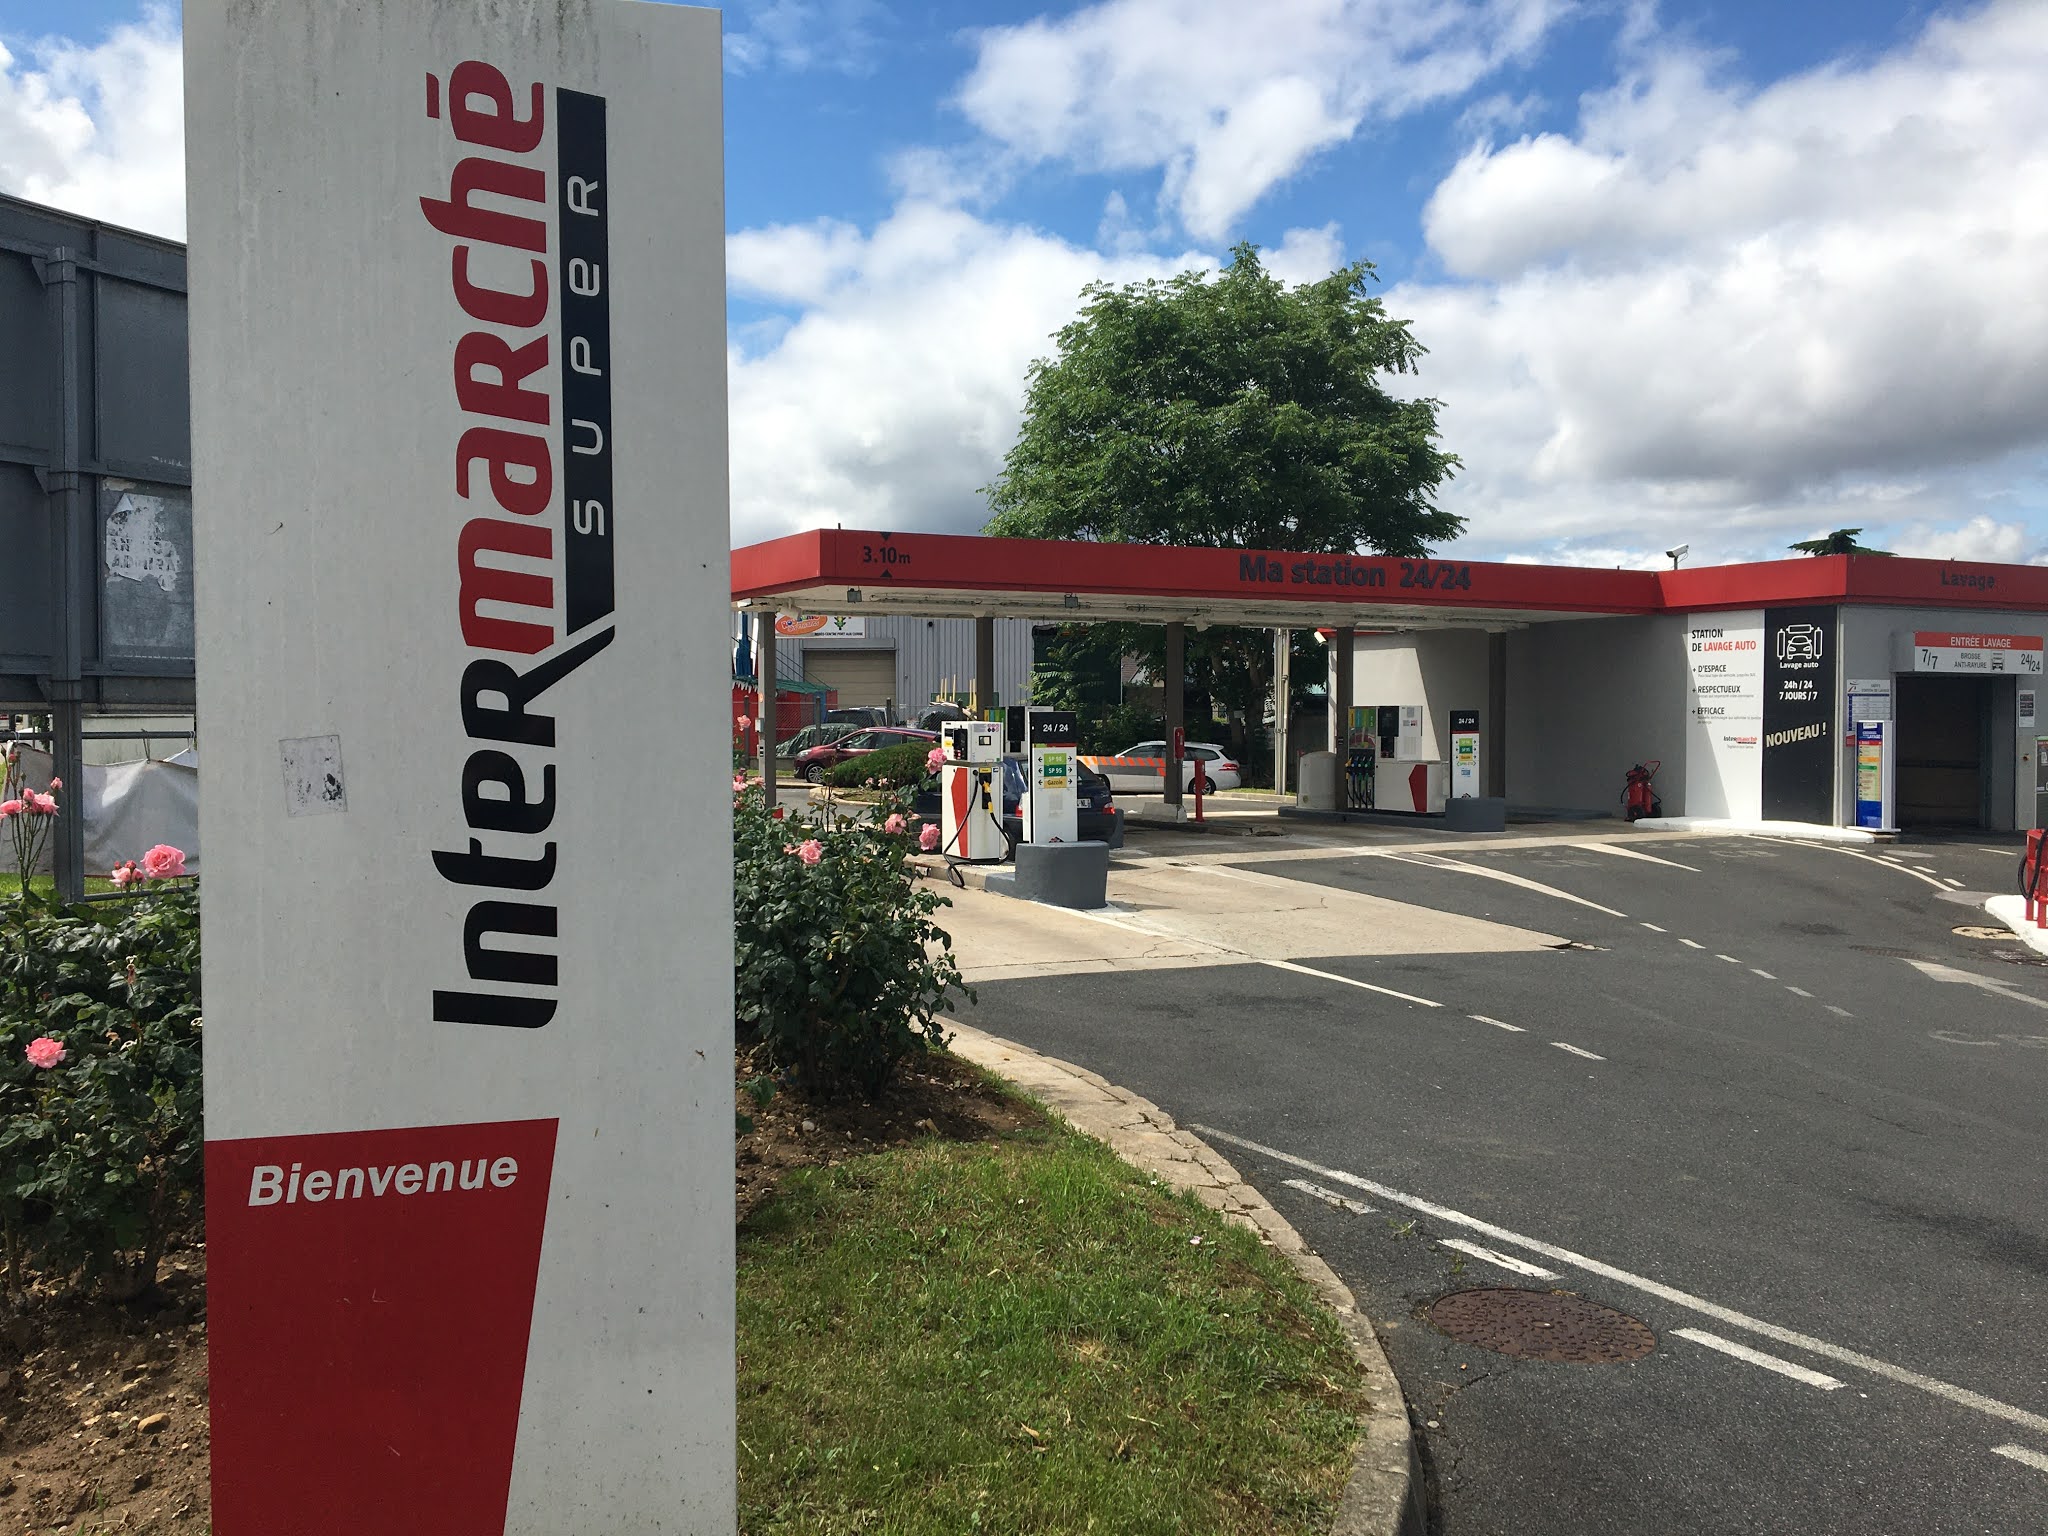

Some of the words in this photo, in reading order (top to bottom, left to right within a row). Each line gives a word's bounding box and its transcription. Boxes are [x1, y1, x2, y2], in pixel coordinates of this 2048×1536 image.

[1239, 554, 1284, 583] Ma
[1291, 558, 1385, 587] station
[1400, 561, 1472, 591] 24/24
[1941, 568, 1996, 591] Lavage
[1691, 628, 1723, 639] STATION
[1692, 642, 1702, 652] DE
[1703, 641, 1733, 652] LAVAGE
[1735, 640, 1757, 651] AUTO
[1950, 635, 1980, 647] ENTRÉE
[1982, 638, 2012, 648] LAVAGE
[1921, 648, 1938, 670] 7/7
[1960, 652, 1981, 660] BROSSE
[1780, 662, 1802, 670] Lavage
[1954, 661, 1987, 669] ANTI-RAYURE
[2020, 653, 2041, 672] 24/24
[1697, 664, 1727, 673] D'ESPACE
[1697, 685, 1741, 693] RESPECTUEUX
[1783, 680, 1798, 689] 24h
[1803, 680, 1813, 689] 24
[1779, 691, 1784, 700] 7
[1784, 691, 1807, 700] JOURS
[1812, 691, 1818, 700] 7
[1697, 707, 1725, 715] EFFICACE
[1042, 723, 1053, 733] 24
[1058, 723, 1069, 732] 24
[1766, 723, 1820, 748] NOUVEAU
[1822, 721, 1827, 736] !
[247, 1155, 519, 1207] Bienvenue
